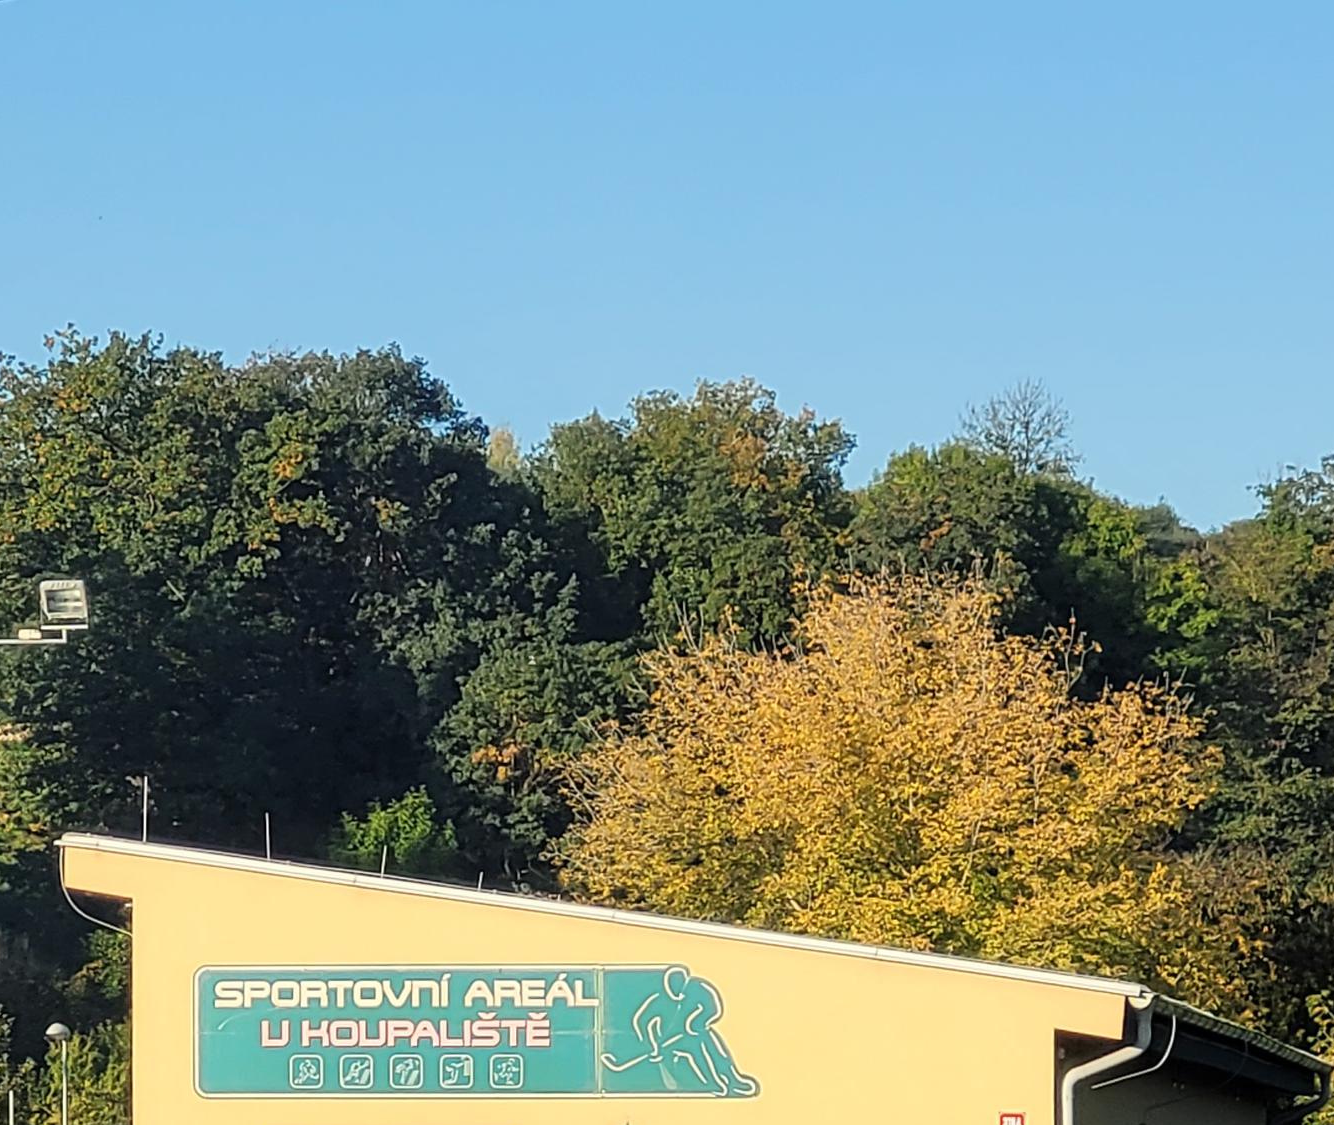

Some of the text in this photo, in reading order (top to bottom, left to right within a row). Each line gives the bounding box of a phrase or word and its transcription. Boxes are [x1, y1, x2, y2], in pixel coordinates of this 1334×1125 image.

[214, 972, 599, 1008] SPORTOVNÍ AREÁL
[260, 1012, 551, 1048] U KOUPALIŠTĚ
